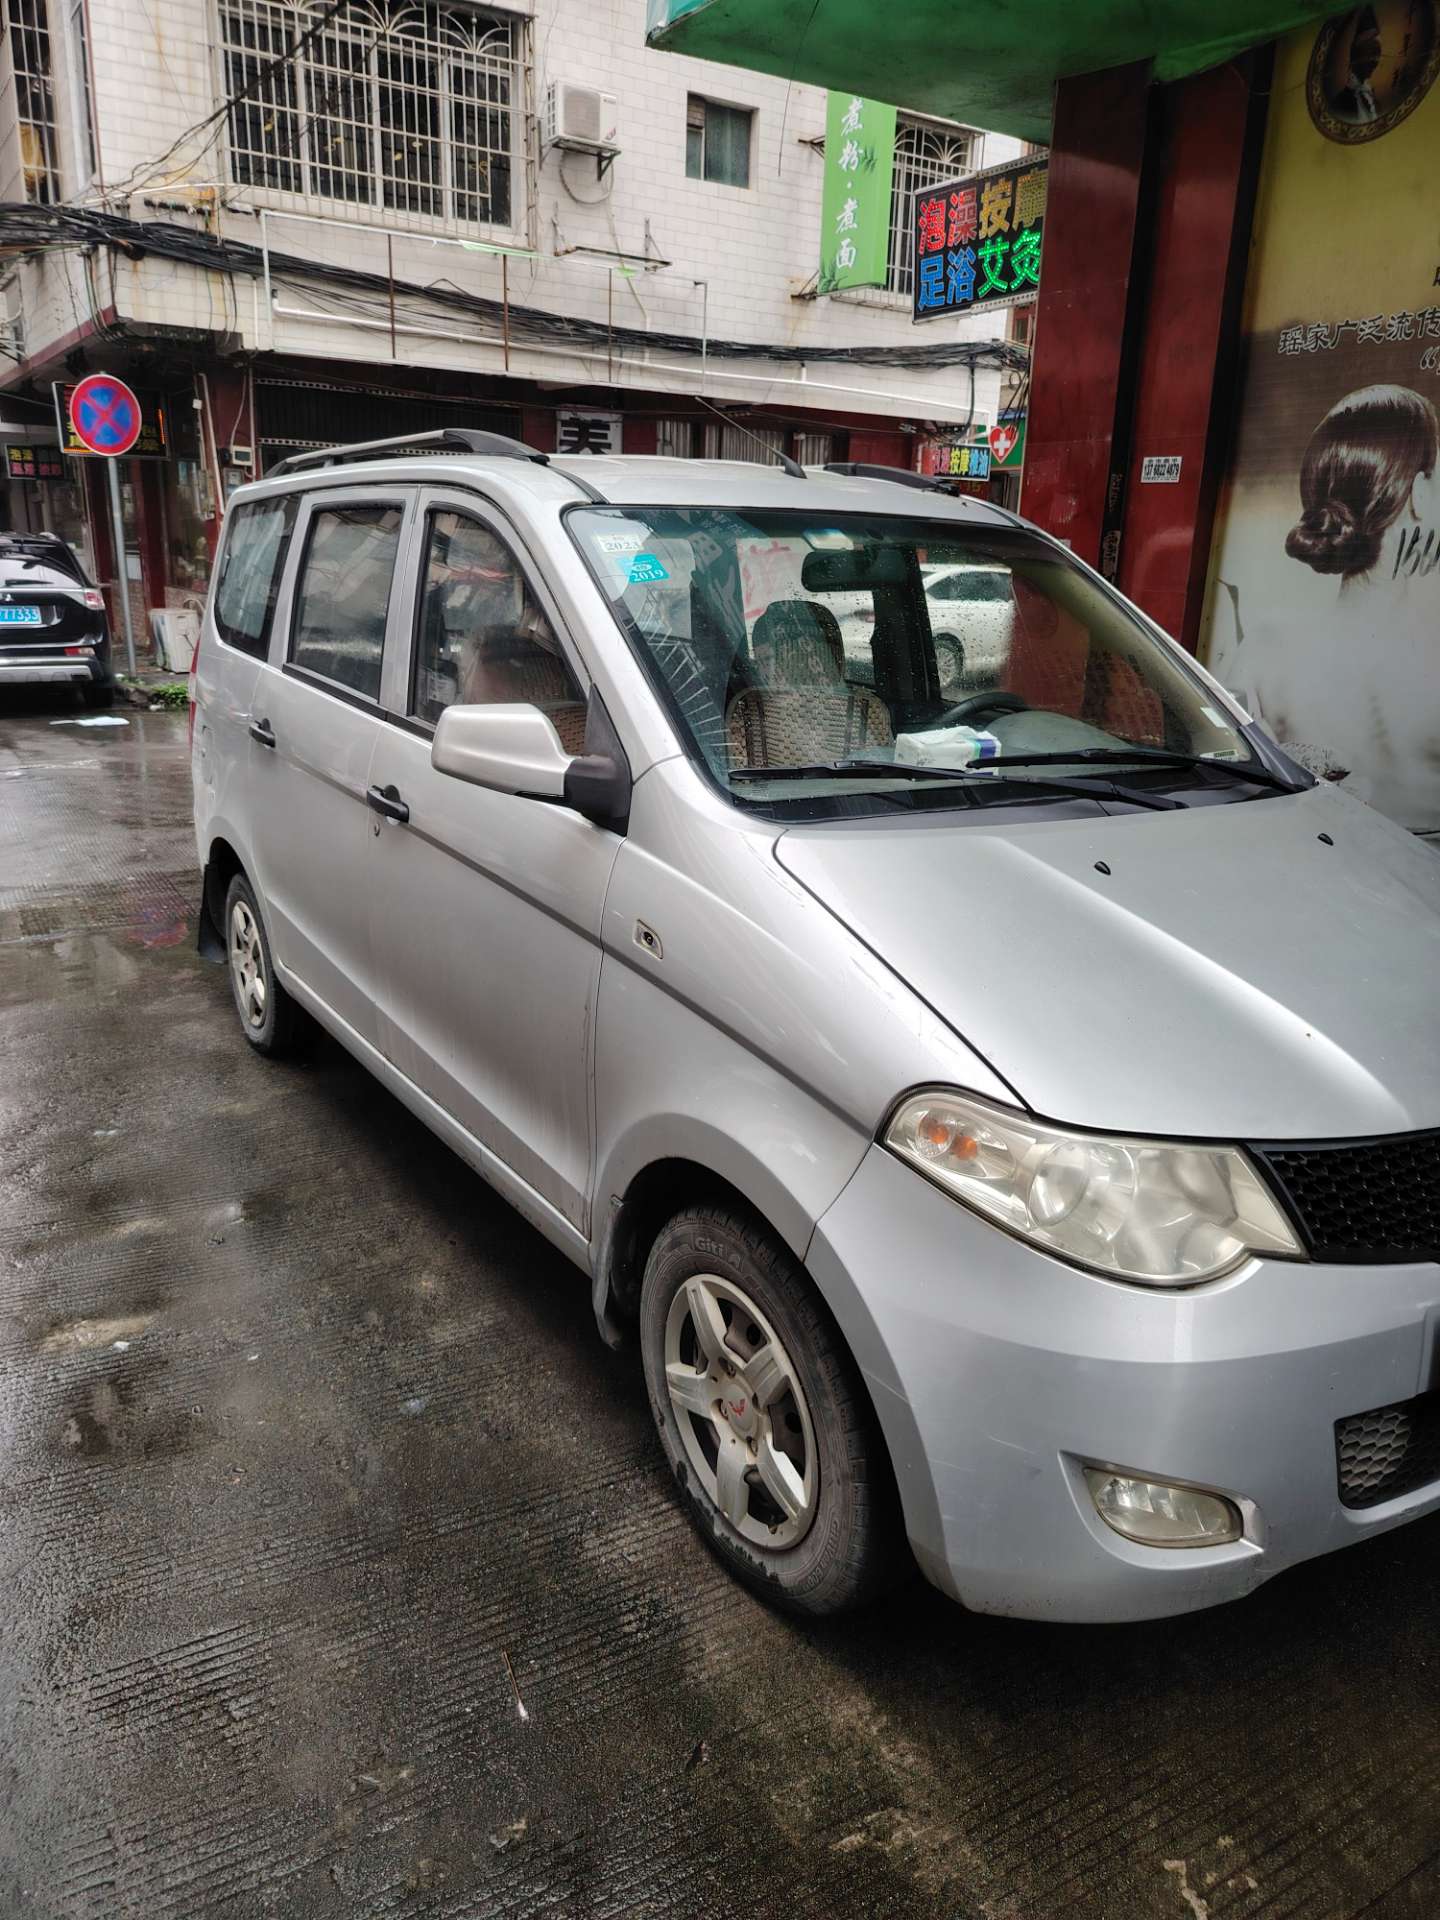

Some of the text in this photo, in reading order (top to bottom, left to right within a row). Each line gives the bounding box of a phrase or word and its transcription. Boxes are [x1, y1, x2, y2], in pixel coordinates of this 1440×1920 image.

[631, 570, 664, 582] 2019
[0, 608, 38, 621] 77333
[694, 1236, 724, 1257] Giti
